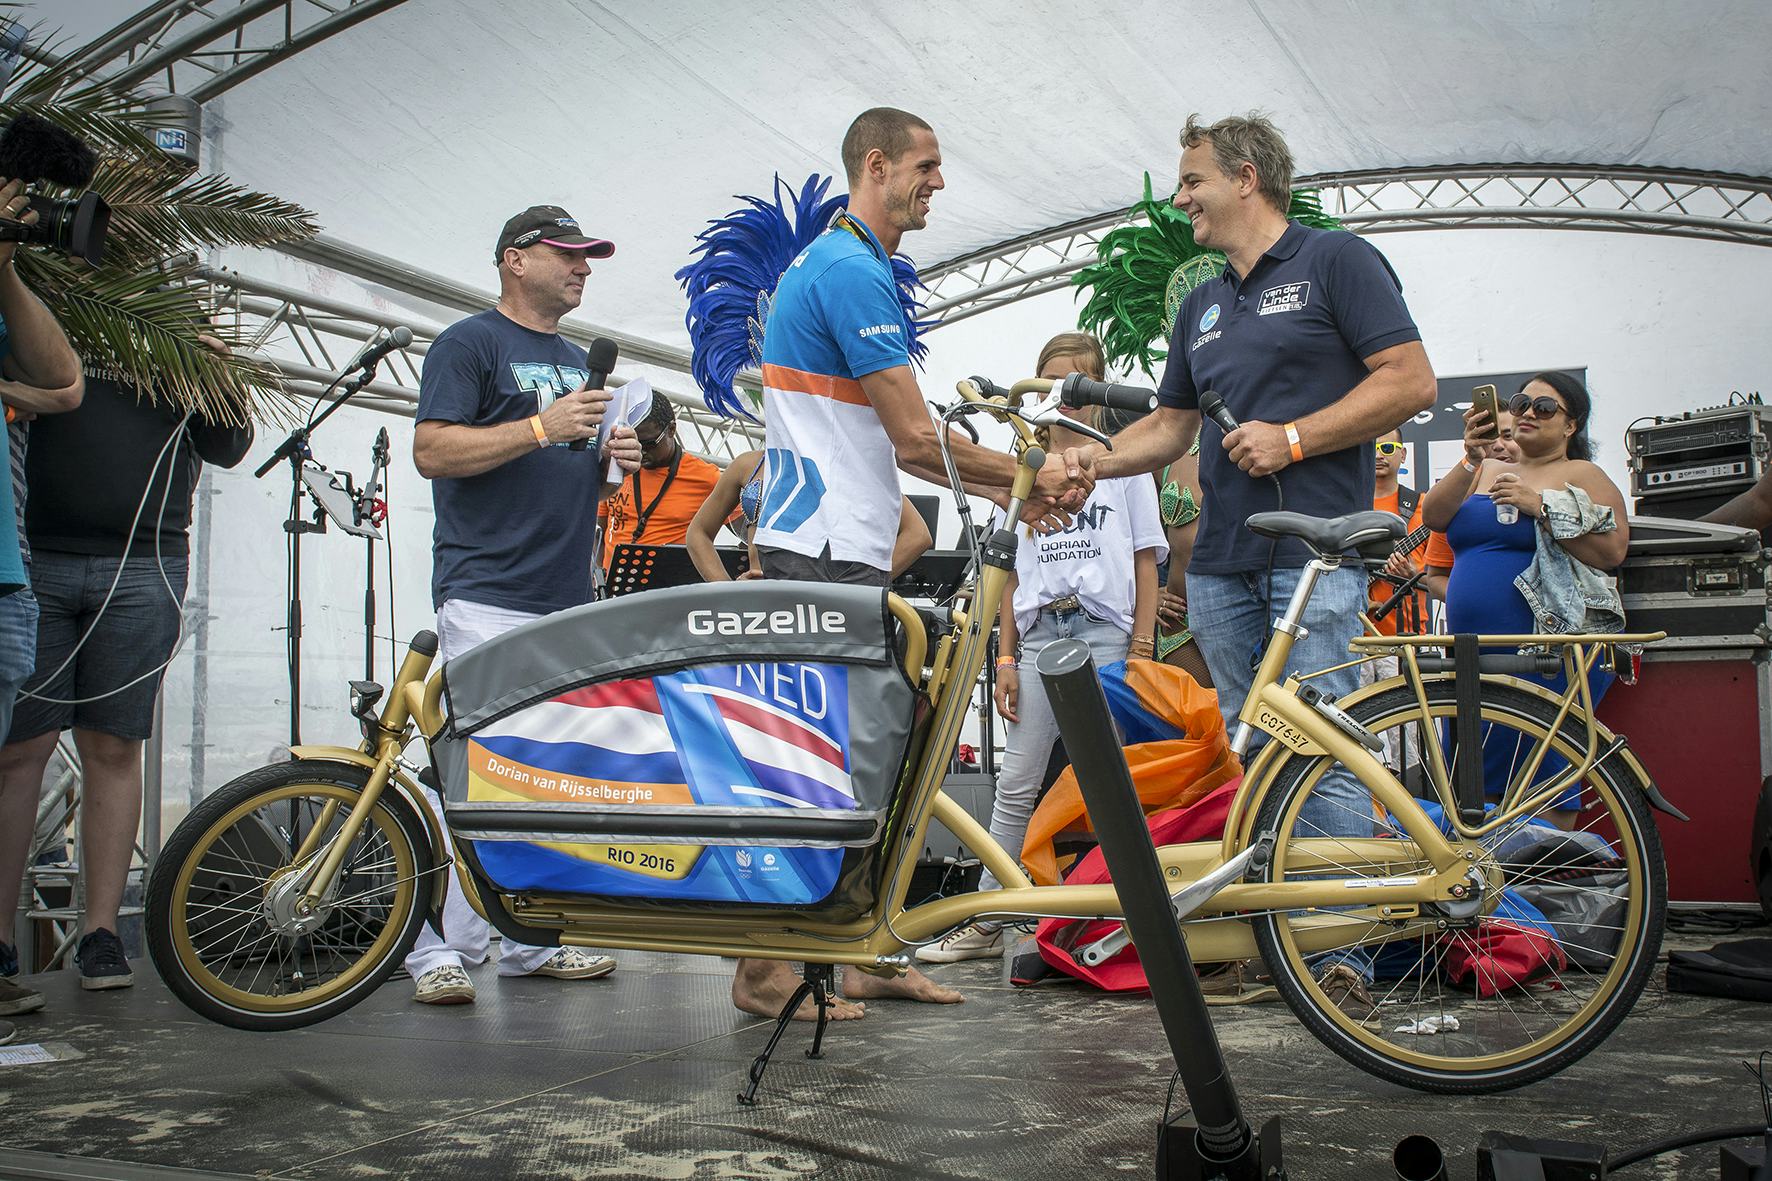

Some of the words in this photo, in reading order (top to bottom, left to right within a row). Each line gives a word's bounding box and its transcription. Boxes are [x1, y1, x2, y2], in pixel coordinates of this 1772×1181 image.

[1262, 293, 1299, 308] Linde
[1265, 287, 1282, 298] van
[1283, 284, 1302, 295] der
[860, 324, 900, 338] SAMSUNG
[1193, 331, 1222, 351] Gazelle
[1037, 547, 1102, 564] UNDATION
[1041, 540, 1091, 552] DORIAN
[687, 604, 846, 636] Gazelle
[736, 662, 827, 720] NED
[1337, 713, 1368, 737] TRELOCK
[487, 758, 530, 784] Dorian
[533, 775, 557, 790] van
[559, 779, 653, 803] Rijsselberghe
[608, 847, 635, 864] RIO
[639, 853, 675, 872] 2016
